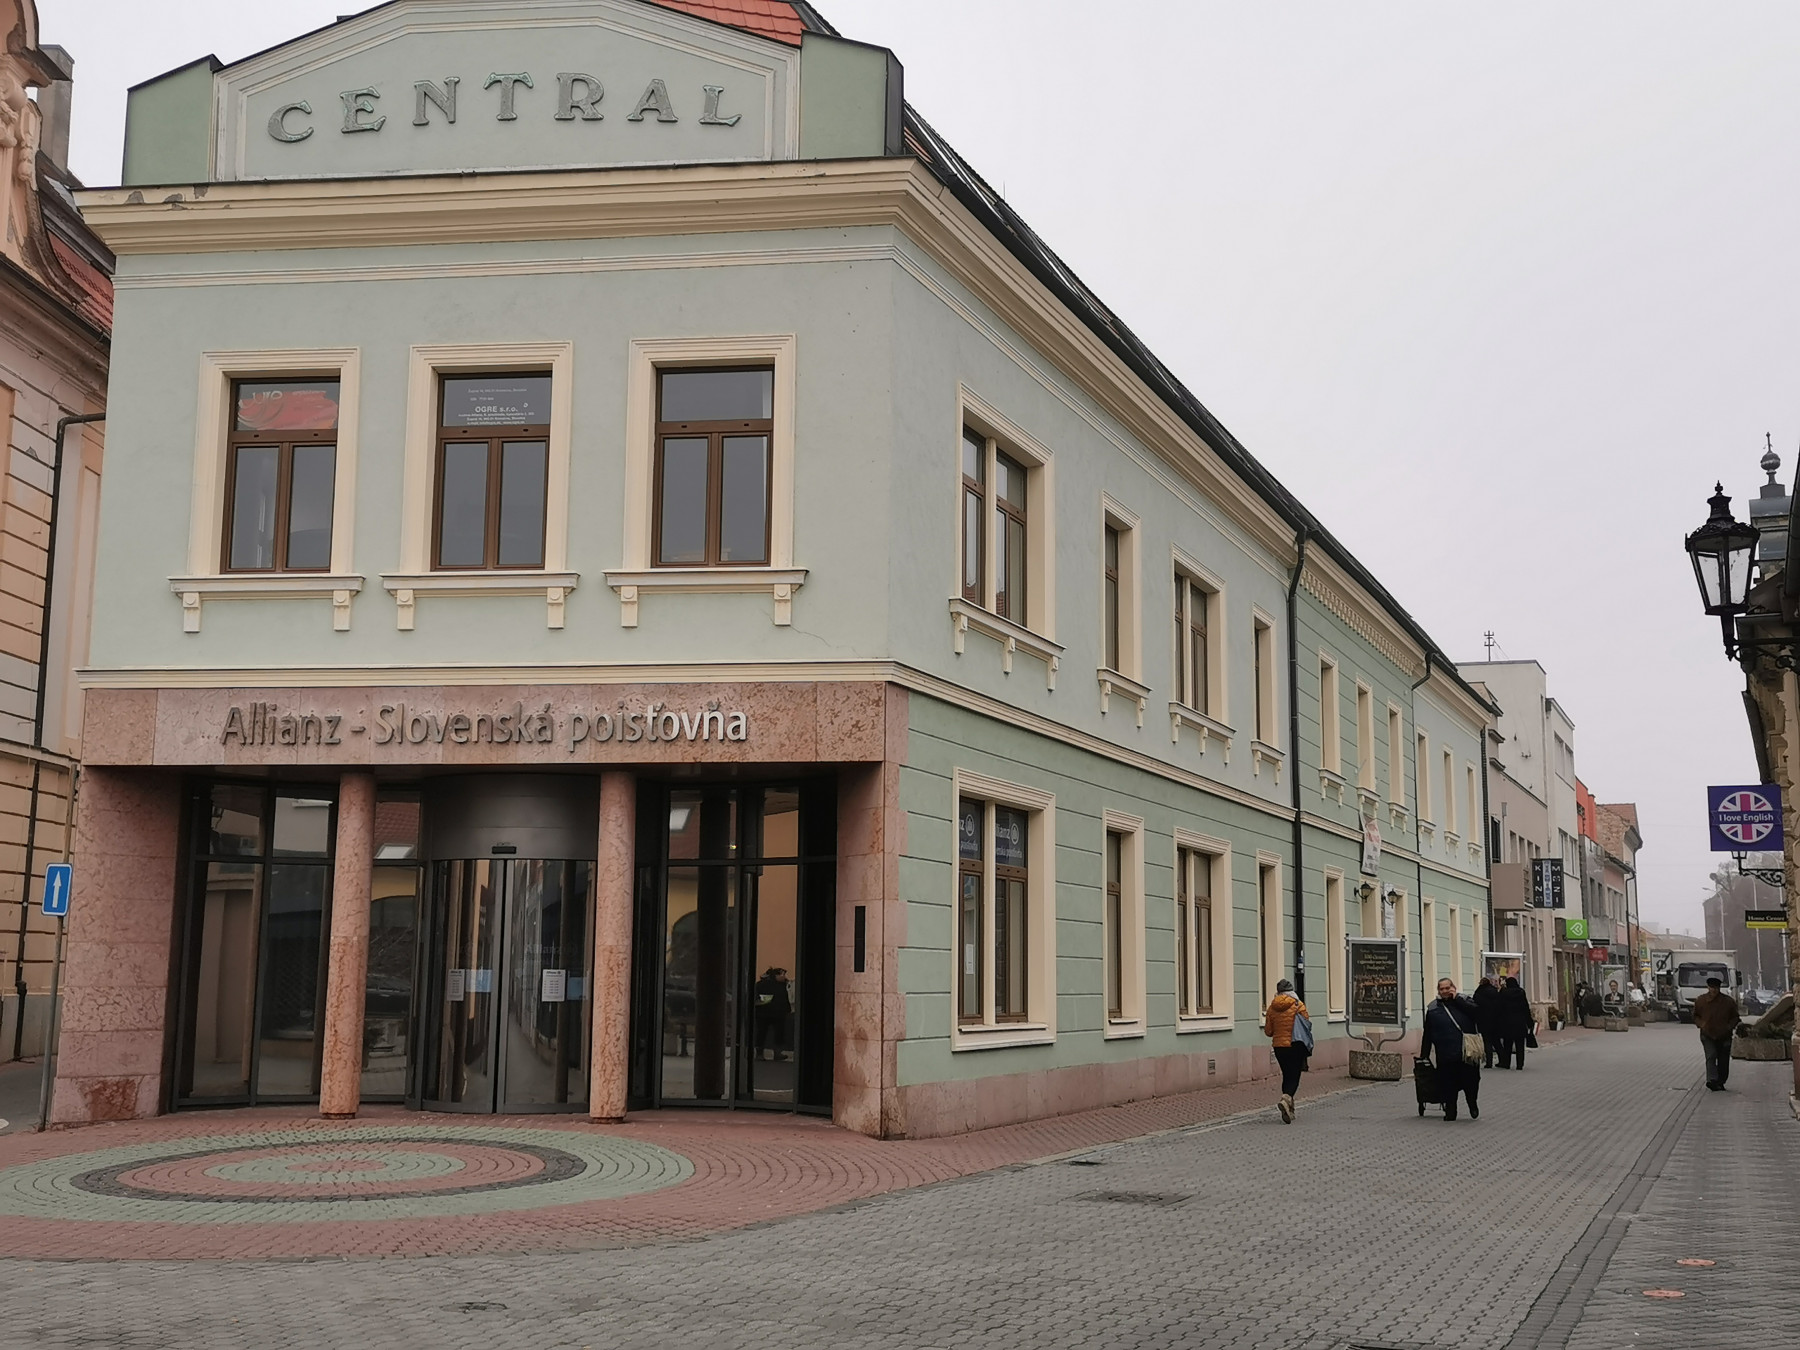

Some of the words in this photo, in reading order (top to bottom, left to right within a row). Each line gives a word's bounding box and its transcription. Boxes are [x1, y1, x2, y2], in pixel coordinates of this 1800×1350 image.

[268, 72, 743, 144] CENTRAL
[219, 704, 342, 745] Allianz
[374, 702, 554, 745] Slovenská
[567, 702, 748, 752] poisťovňa
[1723, 813, 1742, 821] love
[1743, 813, 1774, 823] English
